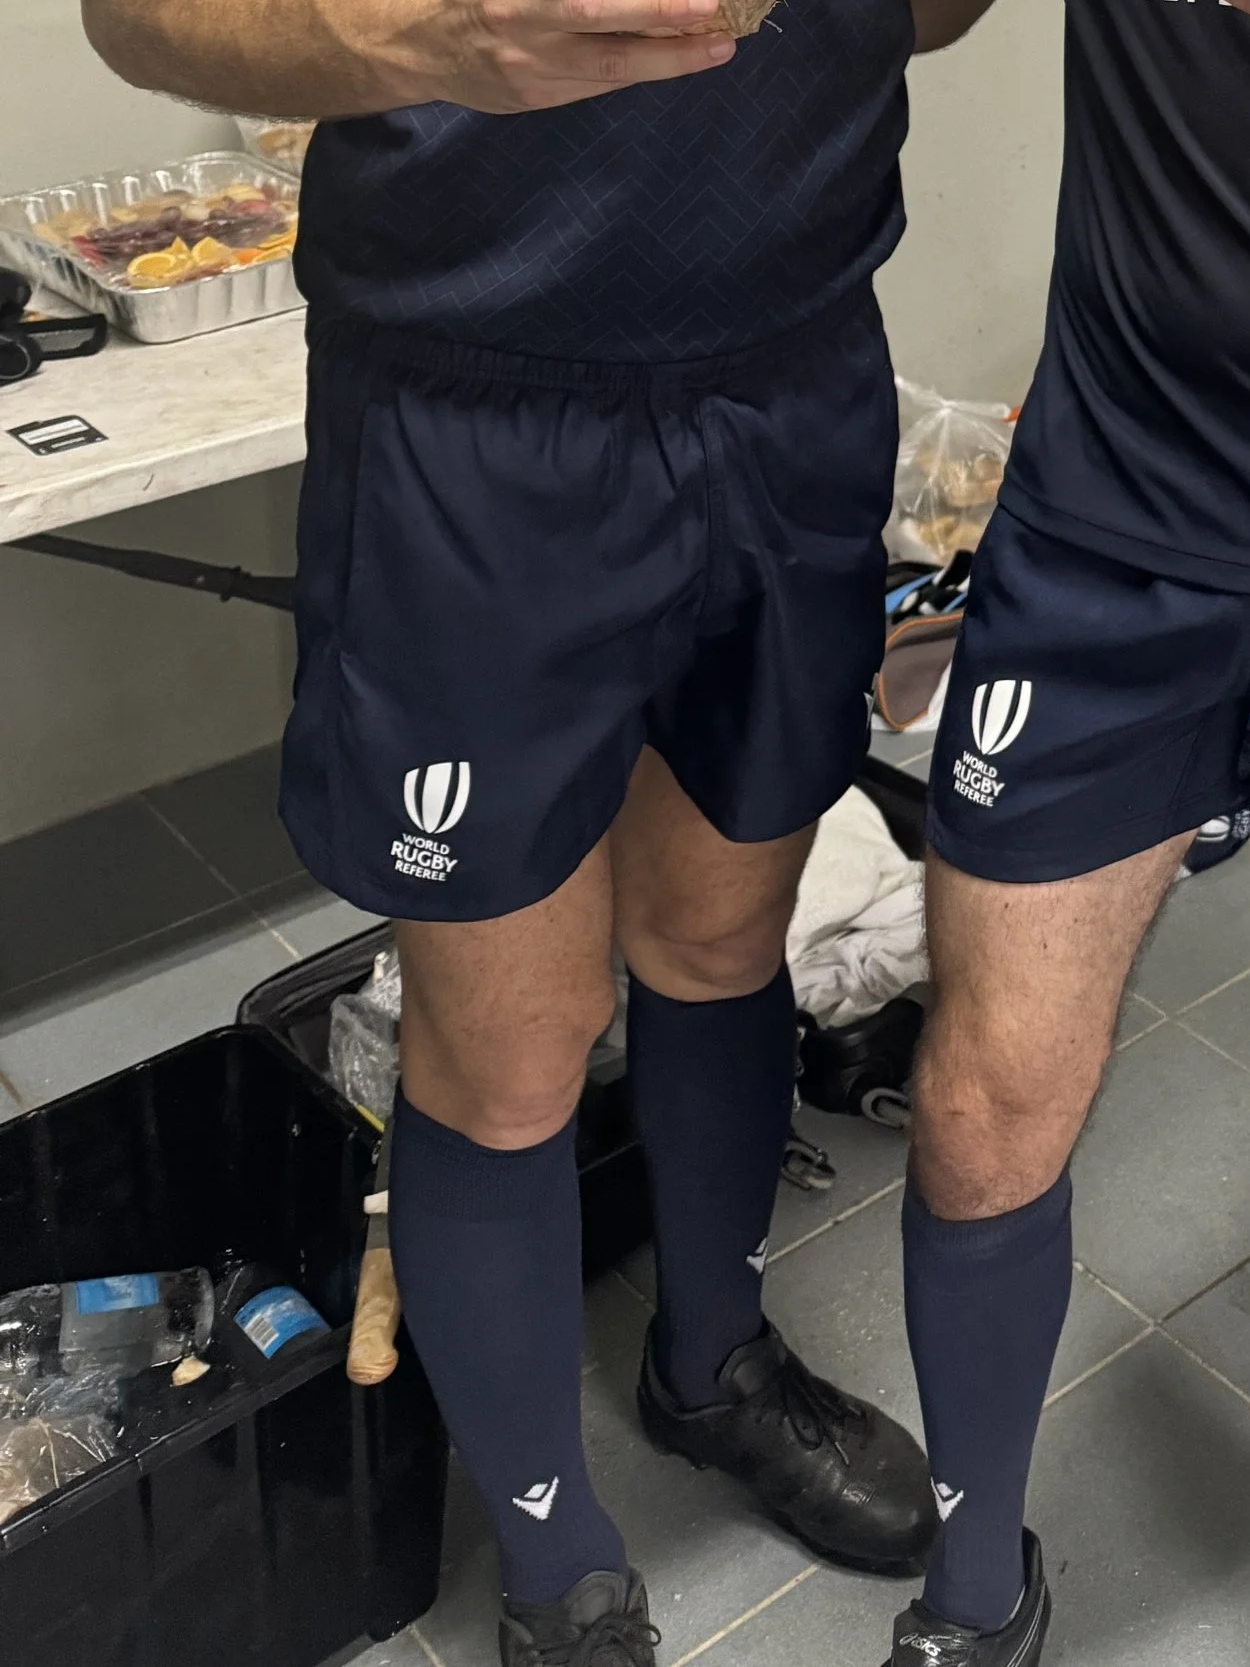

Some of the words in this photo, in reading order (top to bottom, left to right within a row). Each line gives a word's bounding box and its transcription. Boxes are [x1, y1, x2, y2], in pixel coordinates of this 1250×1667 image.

[953, 759, 1005, 797] RUGBY
[963, 750, 997, 778] WORLD
[954, 779, 994, 807] REFEREE
[391, 840, 458, 873] RUGBY
[402, 833, 450, 855] WORLD
[394, 859, 447, 882] REFEREE
